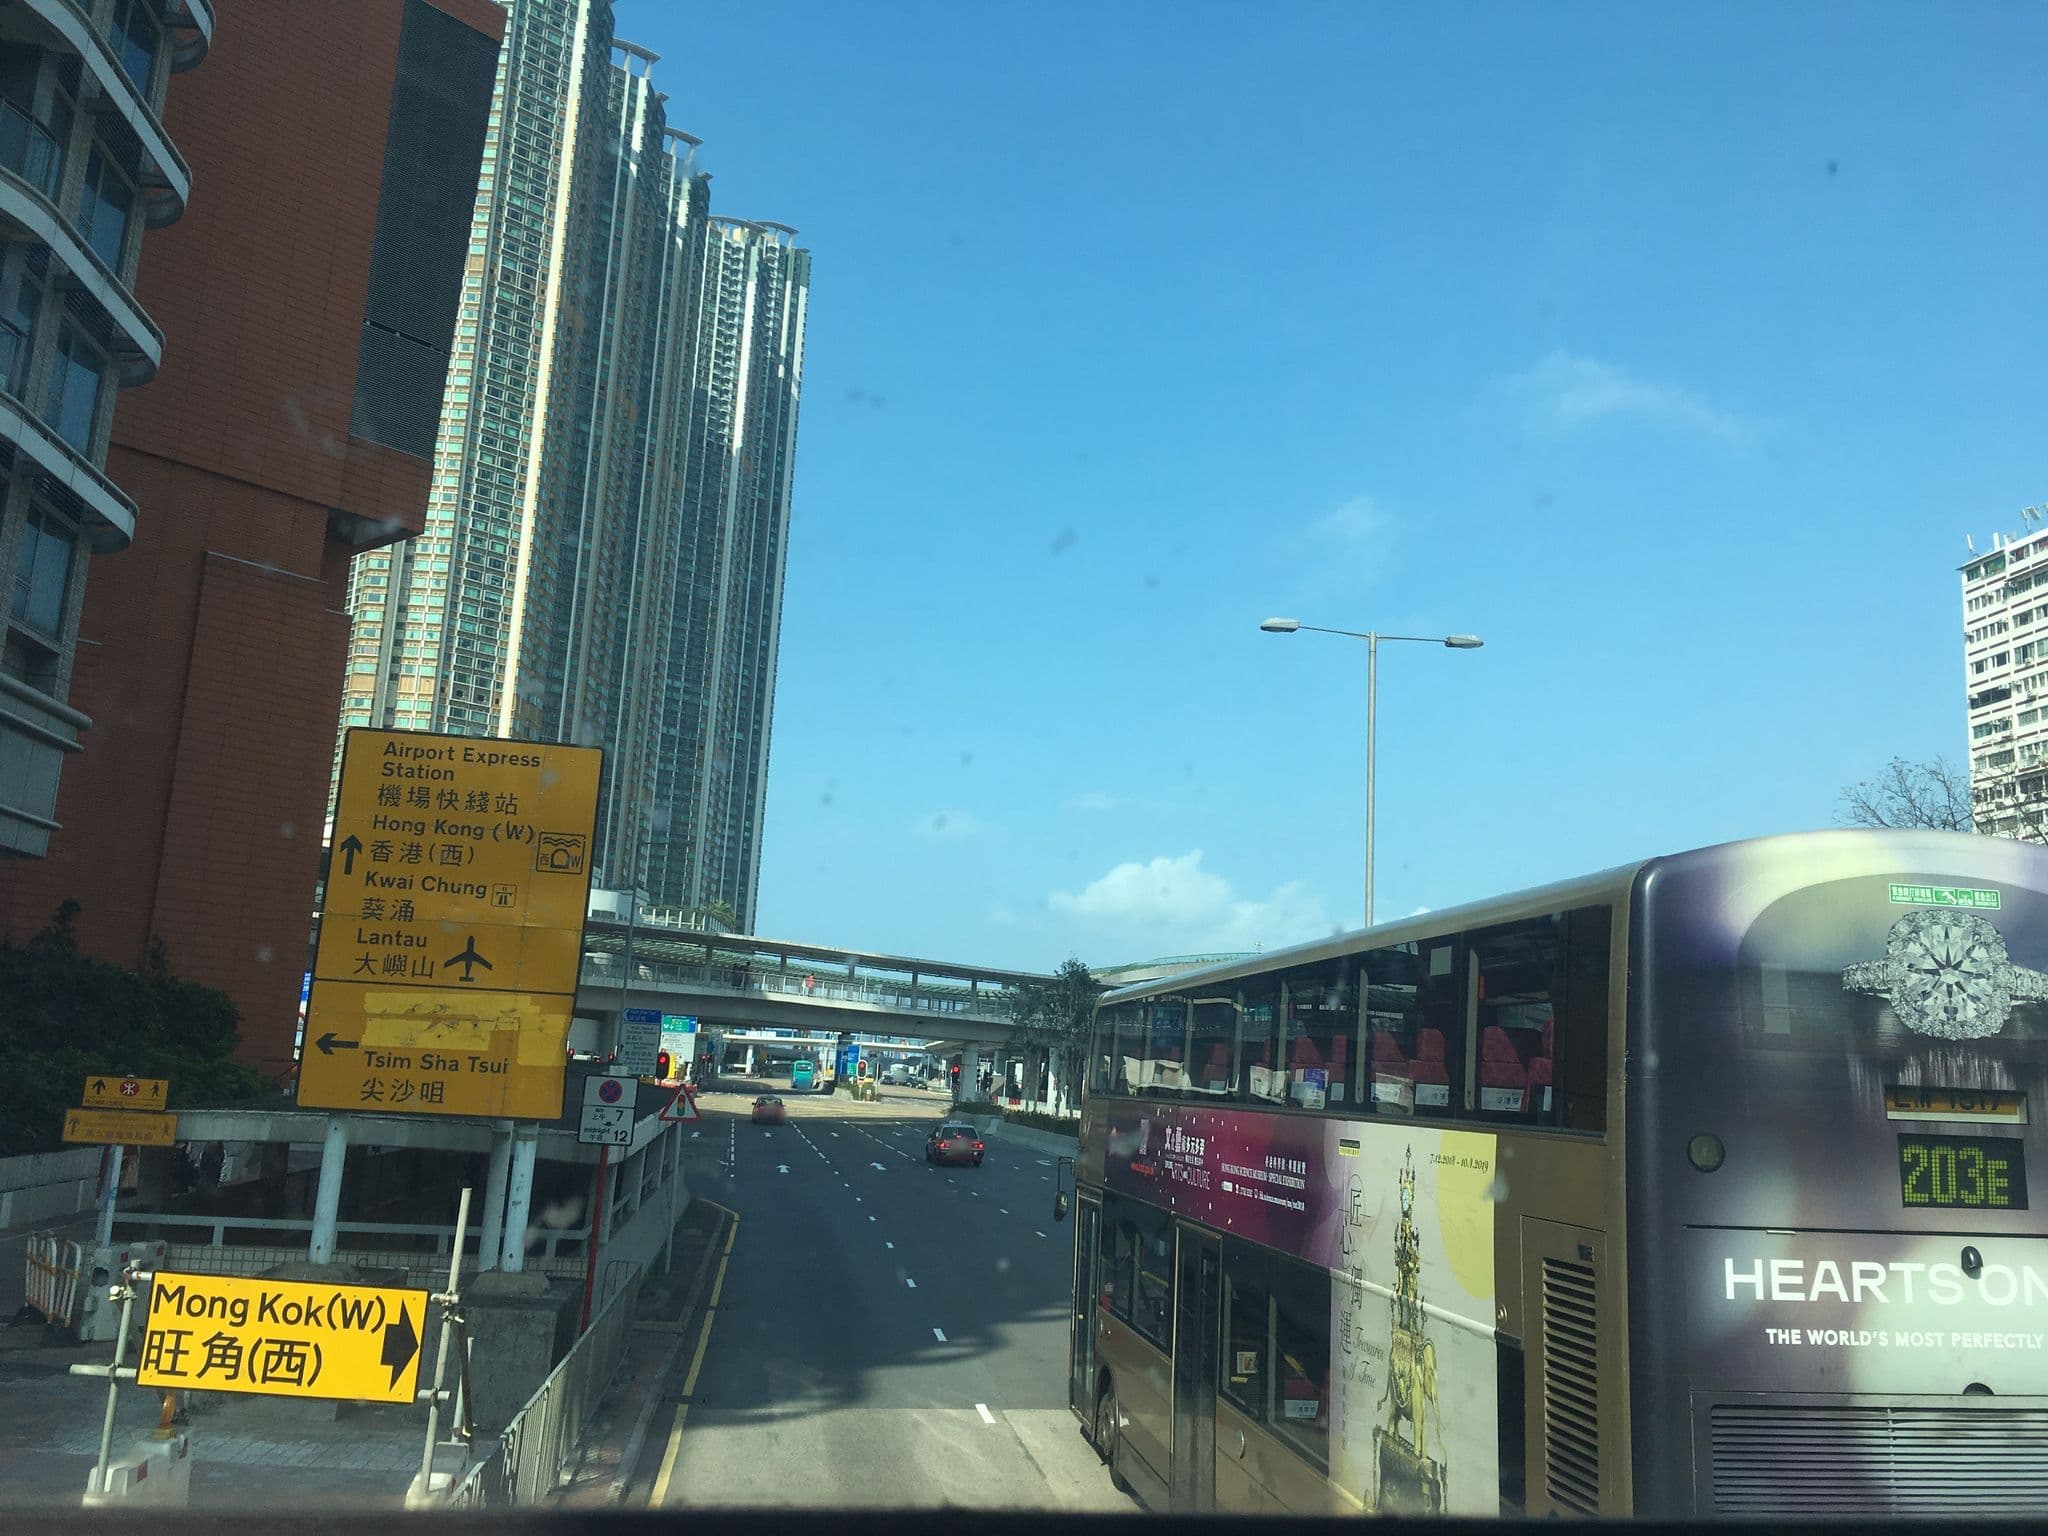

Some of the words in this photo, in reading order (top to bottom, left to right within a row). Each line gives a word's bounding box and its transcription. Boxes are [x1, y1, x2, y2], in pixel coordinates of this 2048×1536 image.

[383, 742, 455, 762] Airport
[463, 747, 540, 768] Express
[381, 762, 454, 782] Station
[377, 783, 519, 816] 機場快綫站
[372, 815, 425, 836] Hong
[433, 818, 485, 842] Kong
[492, 820, 535, 845] (W)
[370, 839, 474, 867] 香港(西)
[540, 853, 550, 866] 西
[571, 855, 581, 867] W
[364, 872, 413, 890] Kwai
[421, 876, 487, 900] Chung
[361, 898, 415, 923] 葵涌
[356, 928, 428, 949] Lantau
[353, 953, 434, 979] 大嶼山
[364, 1051, 411, 1070] Tsim
[419, 1053, 459, 1073] Sha
[467, 1057, 509, 1075] Tsui
[360, 1078, 445, 1105] 尖沙咀
[616, 1110, 624, 1122] 7
[584, 1127, 610, 1135] midnight
[614, 1130, 628, 1142] 12
[1903, 1144, 2008, 1205] 203E
[1724, 1258, 1963, 1305] HEARTS
[1978, 1264, 2048, 1306] ON
[153, 1283, 250, 1328] Mong
[258, 1292, 386, 1334] Kok(W)
[1765, 1328, 1802, 1345] THE
[1806, 1330, 1889, 1346] WORLD'S
[1895, 1332, 1945, 1347] MOST
[1951, 1332, 2046, 1349] PERFECTLY
[143, 1329, 322, 1388] 旺角(西)
